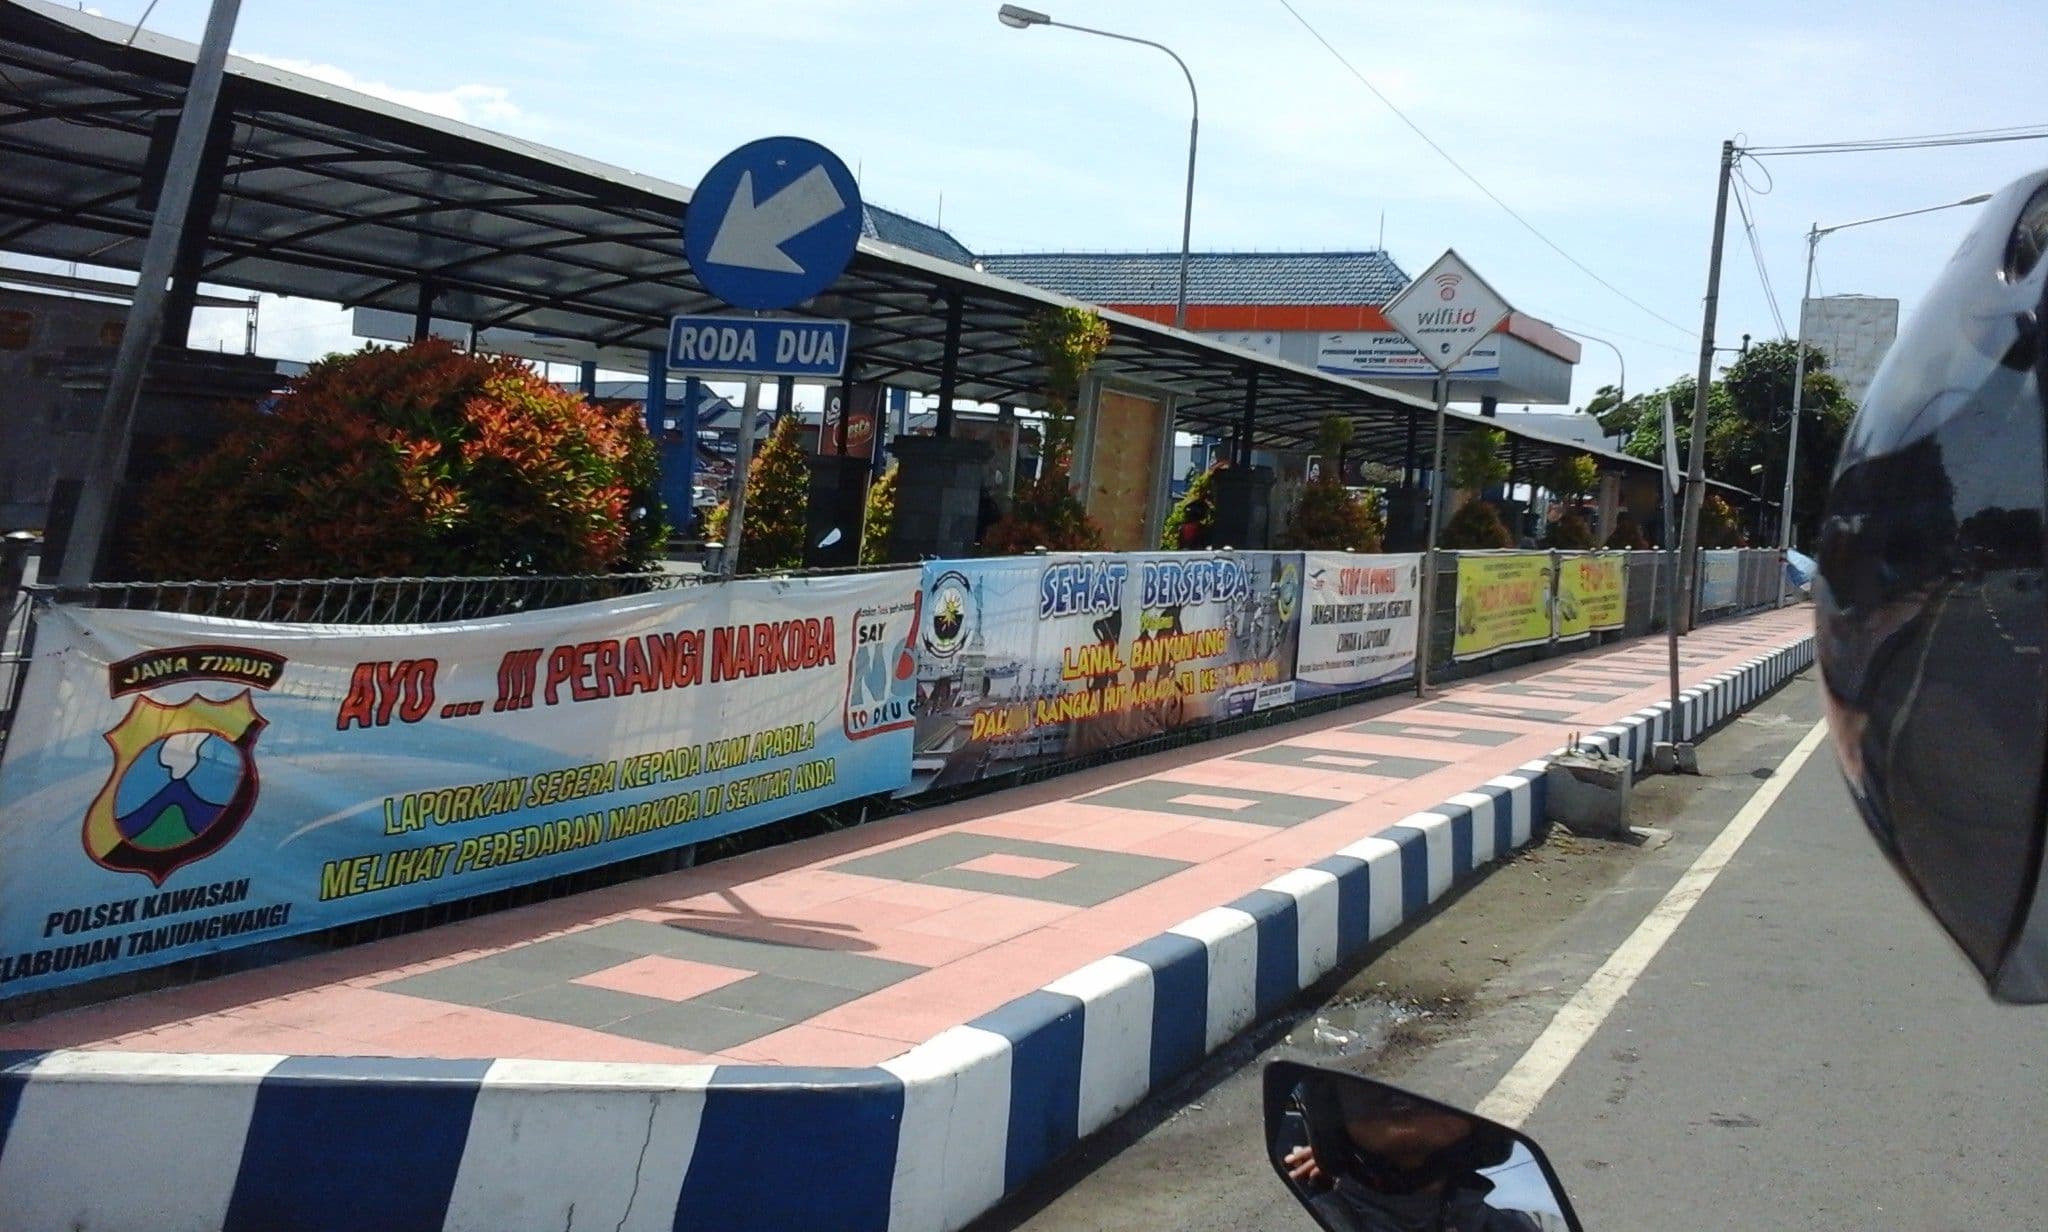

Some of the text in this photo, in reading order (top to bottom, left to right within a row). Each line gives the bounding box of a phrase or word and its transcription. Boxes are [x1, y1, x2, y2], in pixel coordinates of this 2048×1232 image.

[1418, 309, 1477, 326] wifi.id
[678, 325, 835, 365] RODA DUA
[1040, 557, 1250, 620] SEHAT BERSEPEDA
[858, 621, 887, 644] SAY
[123, 655, 274, 685] JAWA TIMUR
[337, 657, 439, 731] AYO
[543, 629, 705, 706] PERANGI
[710, 616, 836, 683] NARKOBA
[1062, 640, 1127, 681] LANAL
[851, 710, 869, 730] TO
[1034, 685, 1100, 727] RANGKA
[383, 721, 817, 836] LAPORKAN SEGERA KEPADA KAMI APABILA
[318, 756, 837, 902] MELIHAT PEREDARAN NARKOBA DI SEKITAR ANDA
[42, 877, 251, 939] POLSEK KAWASAN
[126, 901, 293, 958] TANJUNGWANGI
